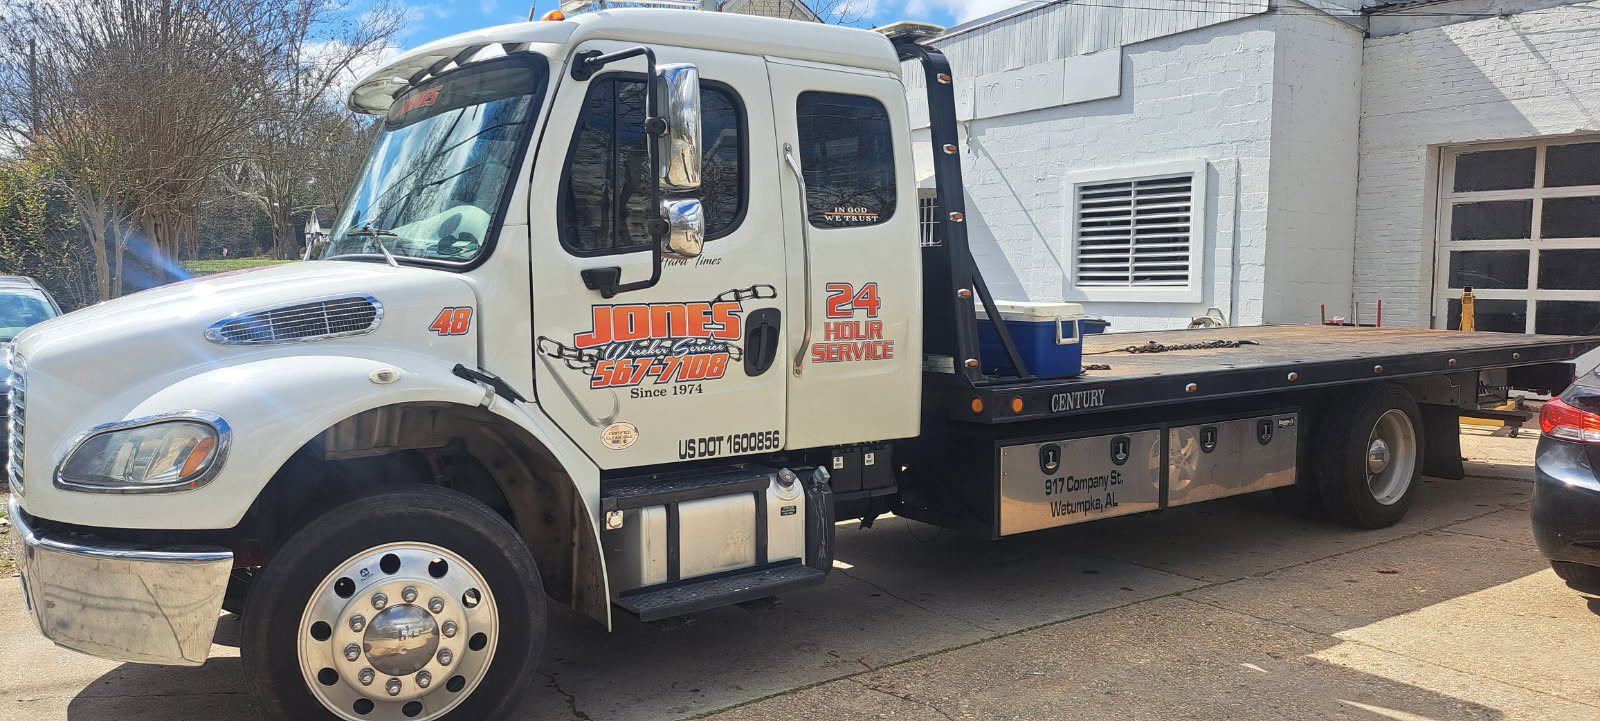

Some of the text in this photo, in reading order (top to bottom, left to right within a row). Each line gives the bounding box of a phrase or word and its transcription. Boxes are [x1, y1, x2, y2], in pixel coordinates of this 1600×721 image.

[826, 282, 881, 319] 24
[428, 306, 473, 336] 48
[574, 301, 743, 349] JONES
[824, 320, 884, 341] HOUR
[605, 338, 726, 360] Wrecker Service
[811, 340, 895, 363] SERVICE
[591, 353, 730, 389] 567-7108
[630, 384, 703, 399] Since 1974
[1051, 388, 1105, 413] CENTURY
[679, 430, 780, 460] US DOT 1600856
[1045, 469, 1124, 496] 917 Company St.
[1050, 491, 1118, 517] Wetumpka, AL
